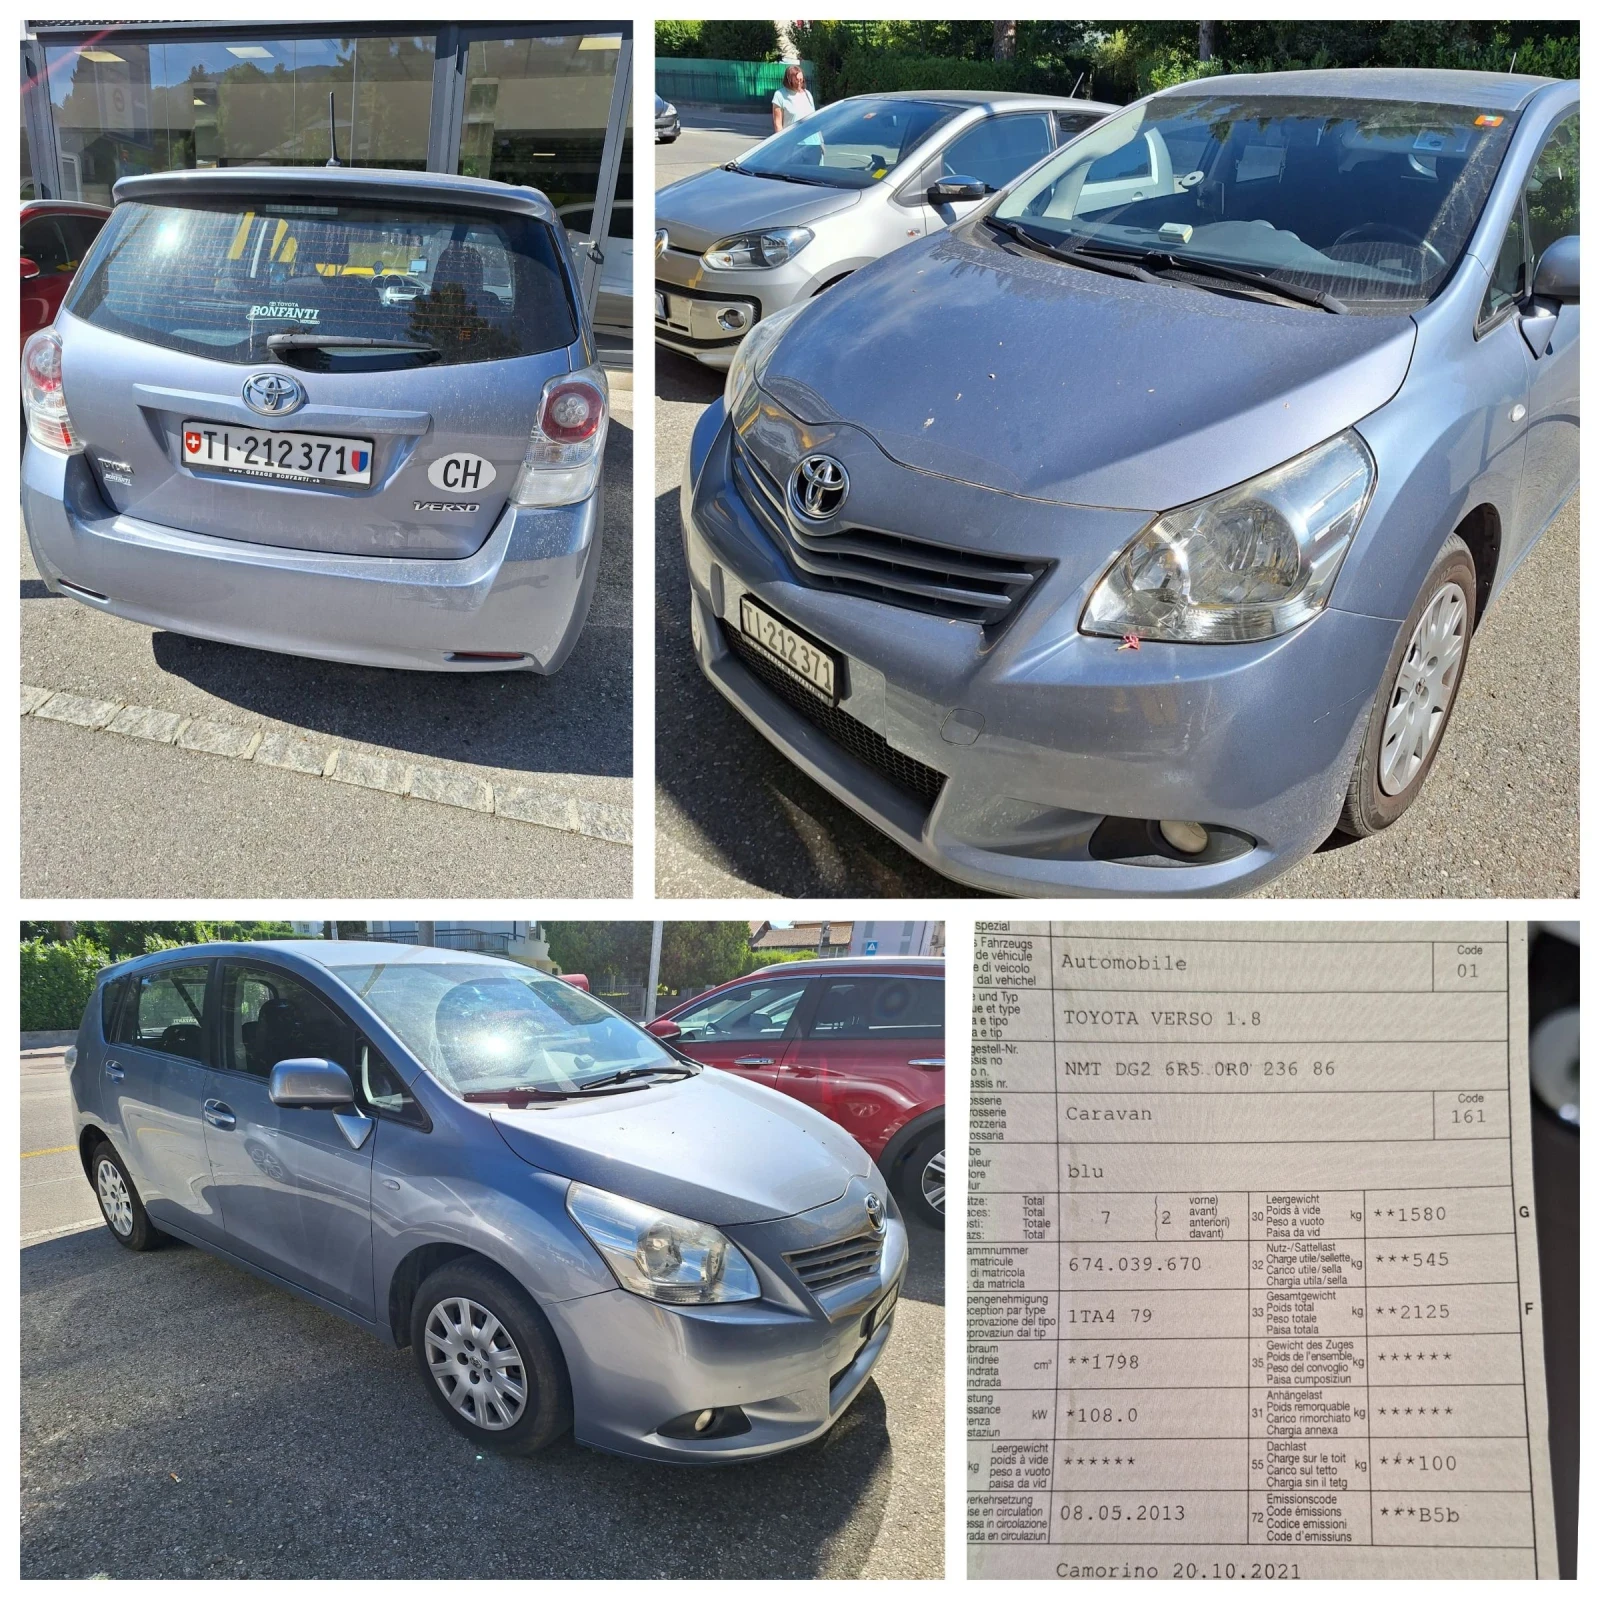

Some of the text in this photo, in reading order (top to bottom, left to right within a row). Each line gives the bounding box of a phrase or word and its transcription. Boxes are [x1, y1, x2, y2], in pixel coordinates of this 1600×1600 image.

[251, 305, 320, 320] BONFANTI
[443, 459, 482, 488] CH
[413, 500, 480, 512] VERSO
[976, 922, 1010, 932] spezial
[981, 937, 1032, 950] Fahrzeugs
[976, 950, 1032, 961] de véhicule
[1457, 946, 1482, 955] Code
[982, 962, 1030, 973] di veicolo
[1062, 954, 1187, 970] Automobile
[1458, 964, 1478, 978] 01
[977, 974, 1036, 986] dal vehichel
[979, 992, 1018, 1004] und Typ
[1064, 1010, 1261, 1026] TOYOTA VERSO 1.8
[1065, 1062, 1101, 1076] NMT
[1116, 1062, 1150, 1076] DG2
[1166, 1062, 1200, 1076] 6R5
[1264, 1062, 1298, 1076] 236
[1314, 1062, 1334, 1076] 86
[1458, 1094, 1484, 1103] Code
[1066, 1107, 1152, 1120] Caravan
[1452, 1110, 1486, 1124] 161
[1068, 1164, 1104, 1178] blu
[1022, 1196, 1044, 1206] Total
[1266, 1194, 1320, 1206] Leergewicht
[1023, 1207, 1045, 1216] Total
[1266, 1206, 1320, 1215] Poids vide
[1350, 1210, 1362, 1222] kg
[1519, 1206, 1530, 1218] G
[1102, 1211, 1110, 1224] 7
[1162, 1211, 1171, 1224] 2
[1252, 1212, 1264, 1221] 30
[1300, 1217, 1324, 1226] vuoto
[1023, 1218, 1051, 1228] Totale
[1023, 1230, 1045, 1239] Total
[1266, 1228, 1320, 1237] Paisa da vid
[1266, 1242, 1336, 1252] Nutz-/Sattellast
[970, 1257, 1014, 1266] matricule
[1070, 1257, 1202, 1272] 674.039.670
[1252, 1260, 1264, 1270] 32
[1266, 1253, 1350, 1266] Charge utile/sellette
[1351, 1259, 1362, 1270] kg
[982, 1268, 1025, 1277] matricola
[1266, 1264, 1295, 1274] Carico
[972, 1279, 1025, 1288] da matricla
[1266, 1276, 1300, 1288] Chargia
[1266, 1291, 1336, 1302] Gesamtgewicht
[1007, 1306, 1046, 1317] par type
[1252, 1308, 1264, 1317] 33
[1266, 1302, 1314, 1312] Poids total
[1352, 1306, 1364, 1318] kg
[1526, 1302, 1534, 1314] F
[1070, 1308, 1152, 1324] 1TA4 79
[1266, 1314, 1317, 1323] Peso totale
[1022, 1316, 1056, 1328] del tipo
[1017, 1328, 1046, 1340] dal tip
[1266, 1325, 1318, 1334] Paisa totala
[1266, 1340, 1354, 1352] Gewicht des Zuges
[1266, 1351, 1352, 1361] Poids de l'ensemble
[1252, 1358, 1264, 1368] 35
[1352, 1357, 1364, 1368] kg
[1266, 1363, 1348, 1374] Peso del convoglio
[1266, 1374, 1351, 1386] Paisa cumposiziun
[1266, 1390, 1322, 1402] Anhängelast
[1252, 1408, 1263, 1418] 31
[1266, 1402, 1350, 1413] Poids remorquable
[1032, 1410, 1048, 1420] kW
[1266, 1413, 1351, 1423] Carico rimorchiato
[1354, 1408, 1366, 1419] kg
[1266, 1424, 1338, 1438] Chargia annexa
[992, 1443, 1048, 1455] Leergewicht
[1266, 1441, 1306, 1452] Dachlast
[990, 1454, 1048, 1466] poids vide
[1266, 1453, 1346, 1465] Charge sur le toit
[968, 1461, 980, 1473] kg
[1252, 1460, 1264, 1470] 55
[1266, 1465, 1338, 1475] Carico sul tetto
[1355, 1460, 1367, 1472] kg
[990, 1467, 1050, 1478] peso vuoto
[989, 1478, 1046, 1490] paisa da vid
[1266, 1476, 1318, 1490] Chargia sin
[1266, 1494, 1337, 1504] Emissionscode
[983, 1506, 1043, 1516] en circulation
[1060, 1506, 1186, 1521] 08.05.2013
[1266, 1506, 1342, 1516] Code émissions
[1252, 1512, 1264, 1522] 72
[996, 1518, 1048, 1528] circolazione
[1266, 1518, 1347, 1529] Codice emissioni
[988, 1530, 1046, 1540] en circulaziun
[1266, 1530, 1352, 1542] Code d'emissiuns
[1056, 1563, 1300, 1579] Camorino 20.10.2021
